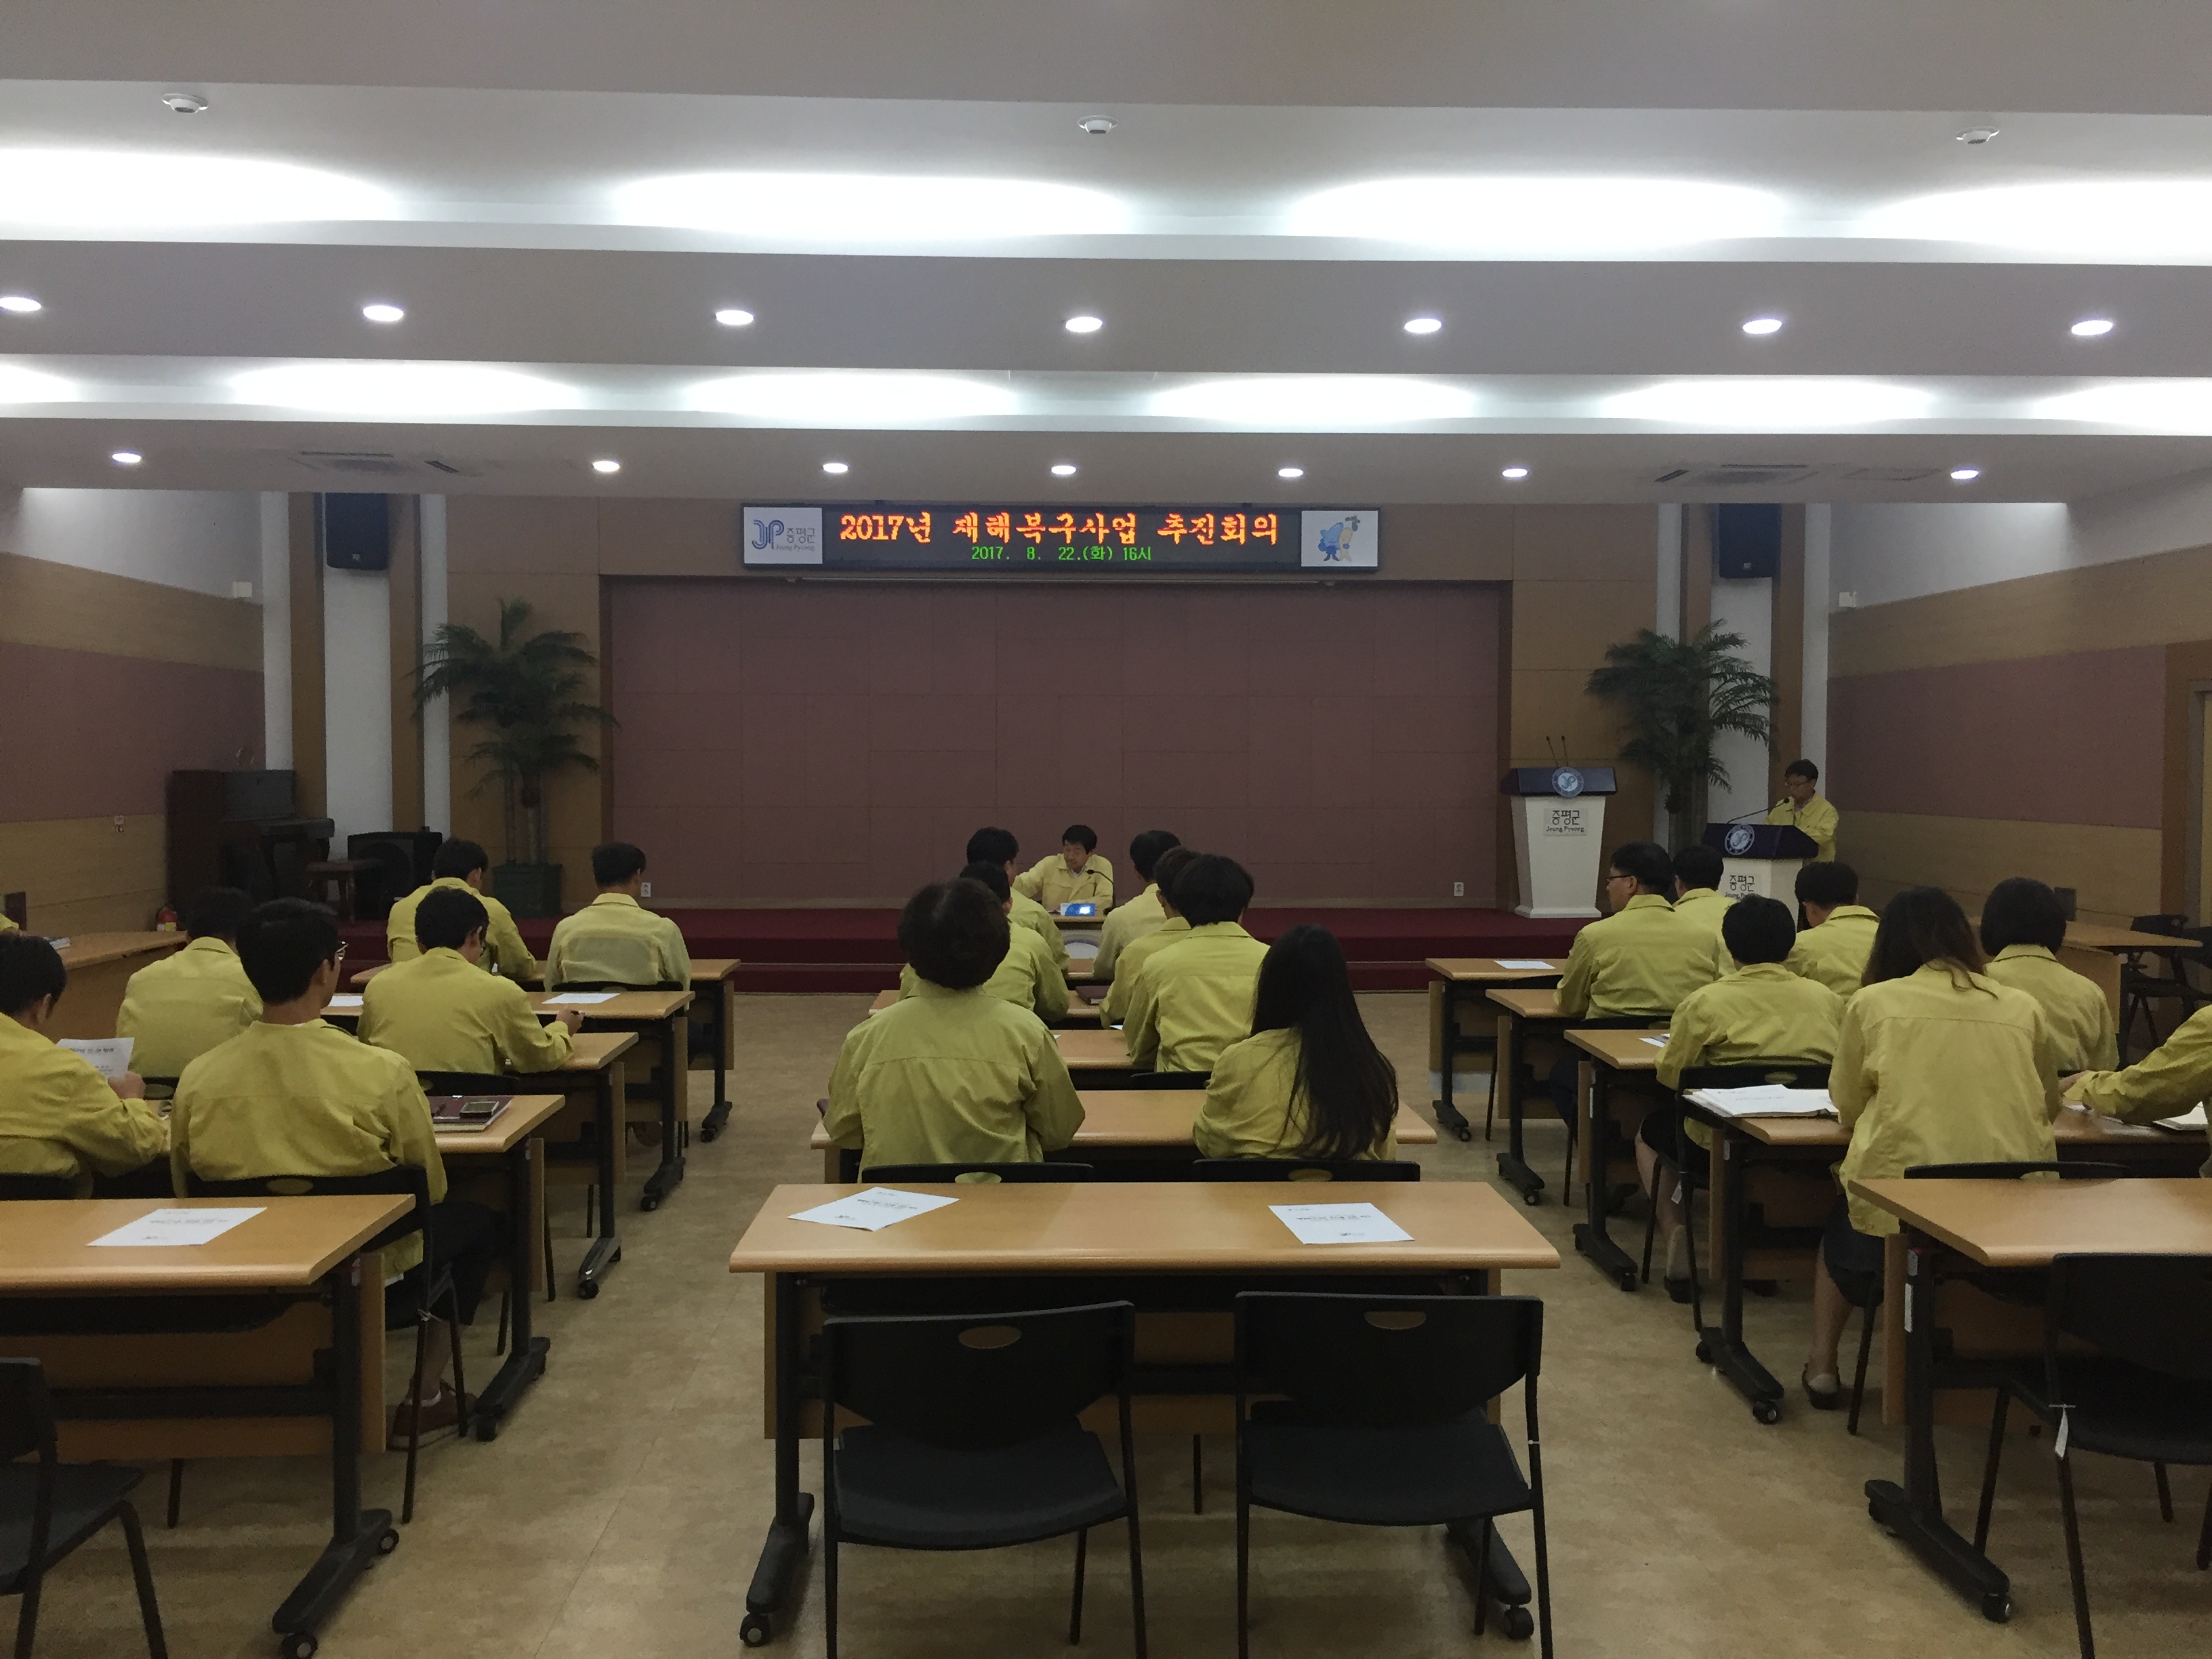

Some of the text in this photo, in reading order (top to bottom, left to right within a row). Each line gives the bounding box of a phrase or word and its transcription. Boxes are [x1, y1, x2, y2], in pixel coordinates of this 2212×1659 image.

[786, 527, 815, 544] 증평군
[840, 512, 1277, 545] 2017년 재해복구사업 추진회의
[971, 546, 1010, 560] 2017.
[1026, 546, 1042, 560] 8.
[1122, 546, 1152, 561] 16시
[1552, 810, 1580, 825] 증평군
[1729, 875, 1755, 892] 증평군
